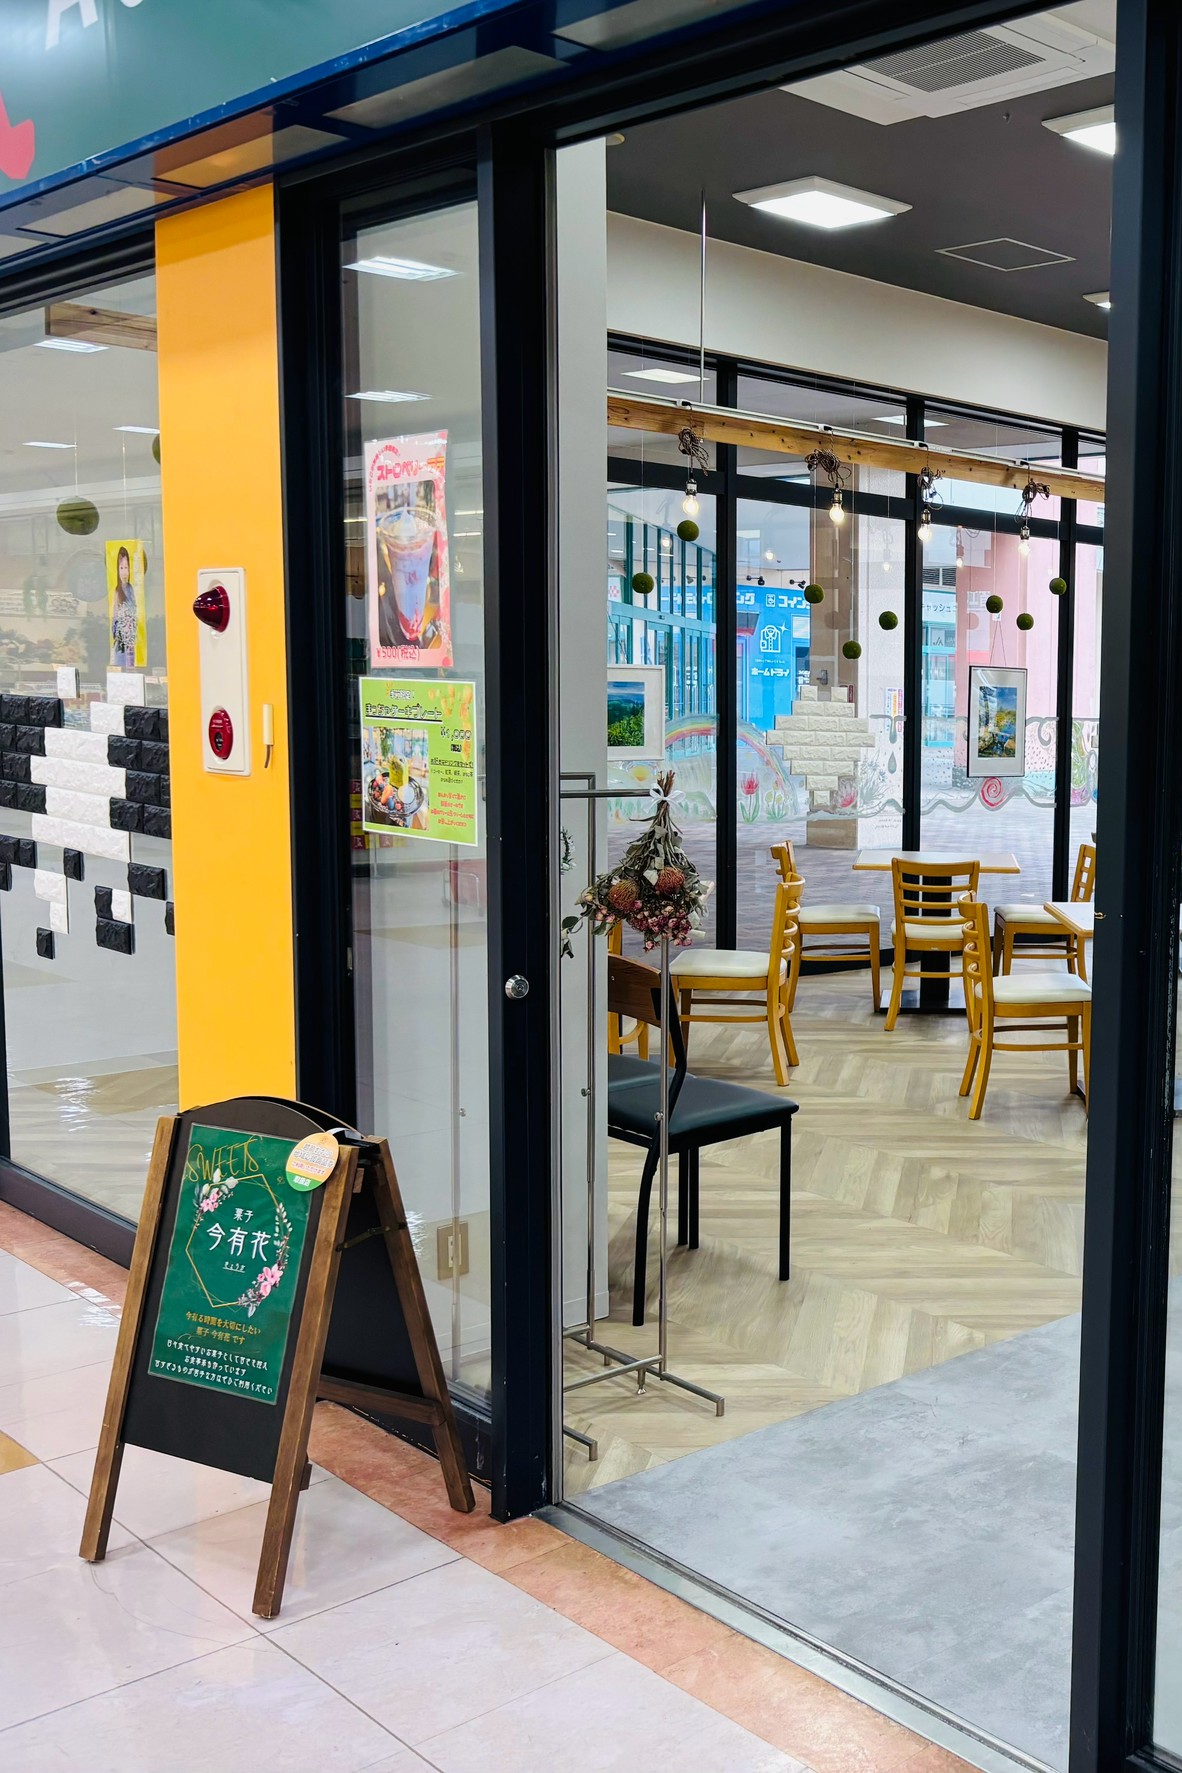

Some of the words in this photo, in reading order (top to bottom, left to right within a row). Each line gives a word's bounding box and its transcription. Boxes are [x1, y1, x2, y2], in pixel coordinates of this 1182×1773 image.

[233, 1207, 254, 1223] 菓子
[206, 1222, 272, 1262] 今有花
